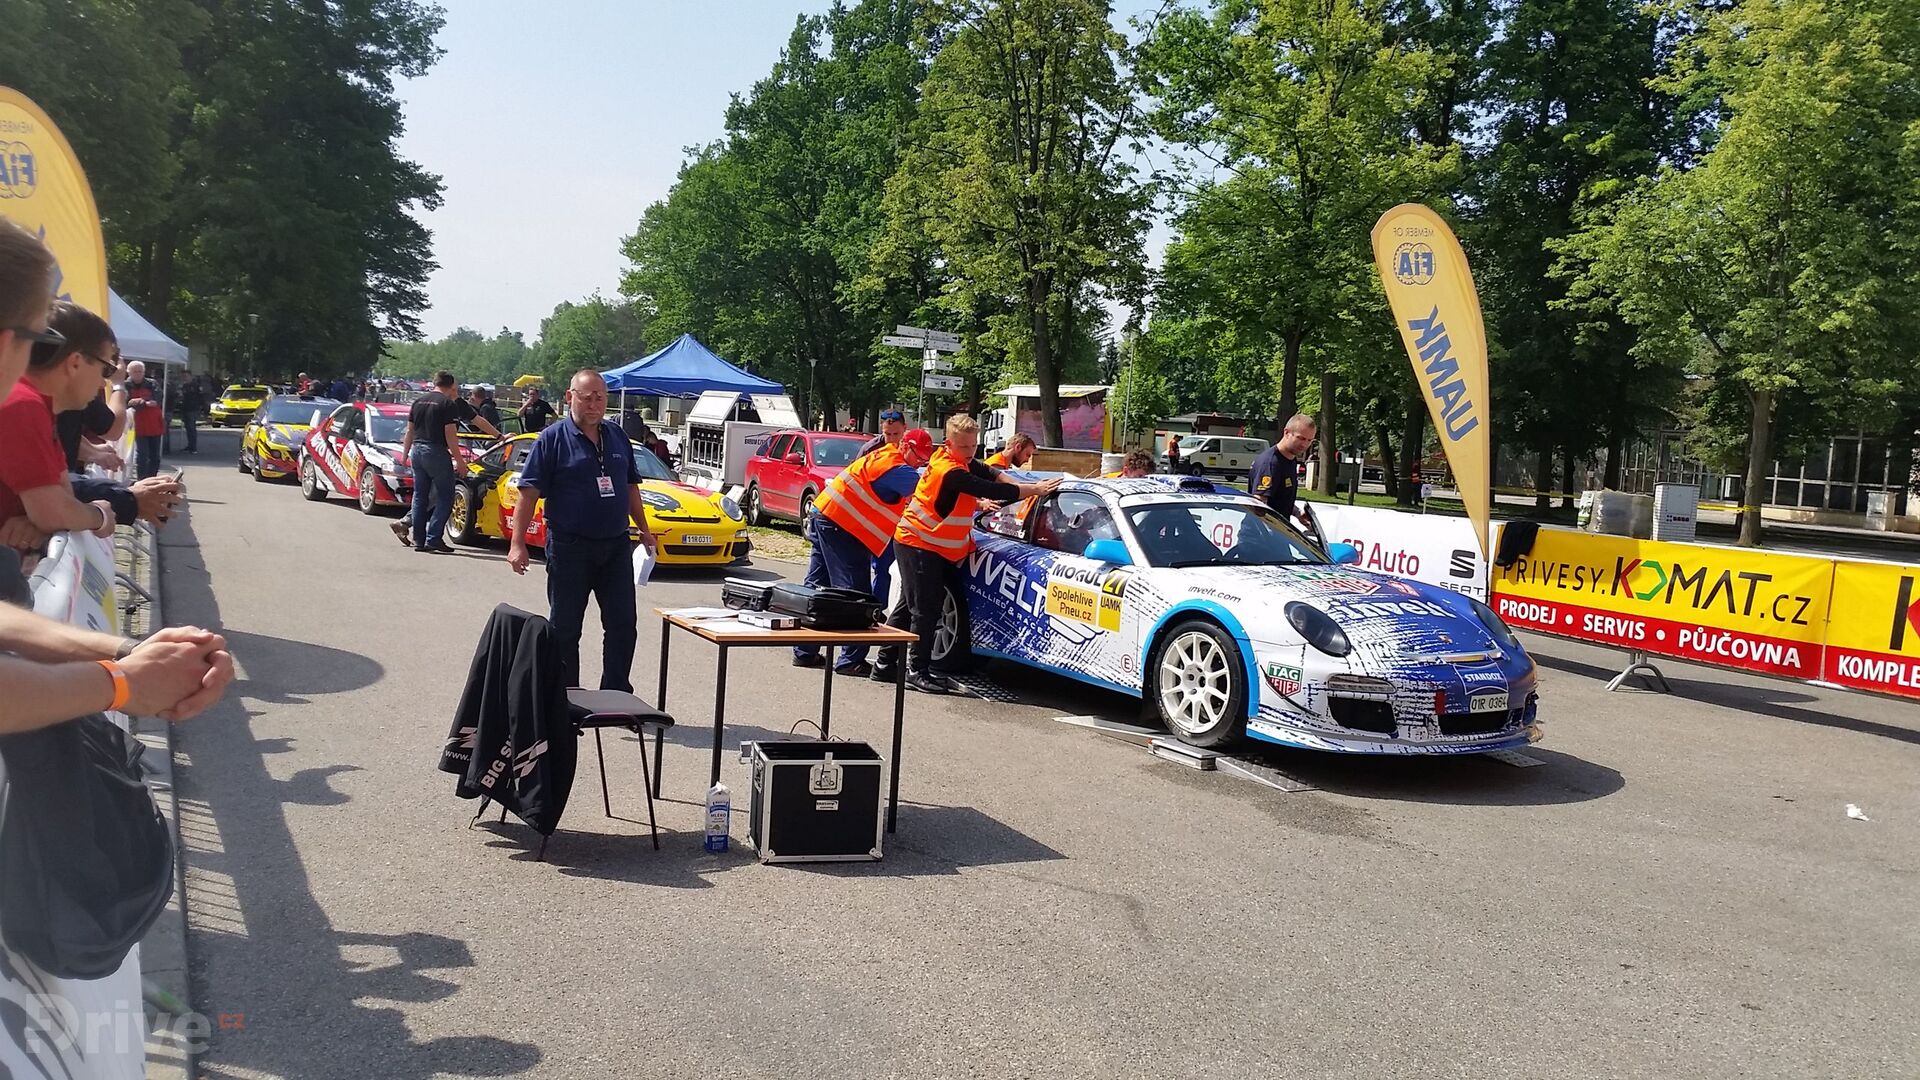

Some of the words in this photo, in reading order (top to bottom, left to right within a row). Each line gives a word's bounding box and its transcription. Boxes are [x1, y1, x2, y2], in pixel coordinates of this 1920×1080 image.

[1367, 542, 1420, 576] Auto
[1052, 563, 1101, 586] MOGUL
[1052, 585, 1094, 608] Spolehlive
[1187, 584, 1242, 603] invelt.com
[969, 584, 1007, 609] RALLIED
[1017, 613, 1050, 640] RACED
[1059, 602, 1093, 622] Pneu.cz
[1500, 598, 1557, 626] PRODEJ
[1583, 613, 1645, 640] SERVIS
[1678, 627, 1802, 668] PŮJČOVNA
[1271, 665, 1300, 681] TAG
[1464, 672, 1504, 682] STANDOX
[480, 759, 507, 789] BIG
